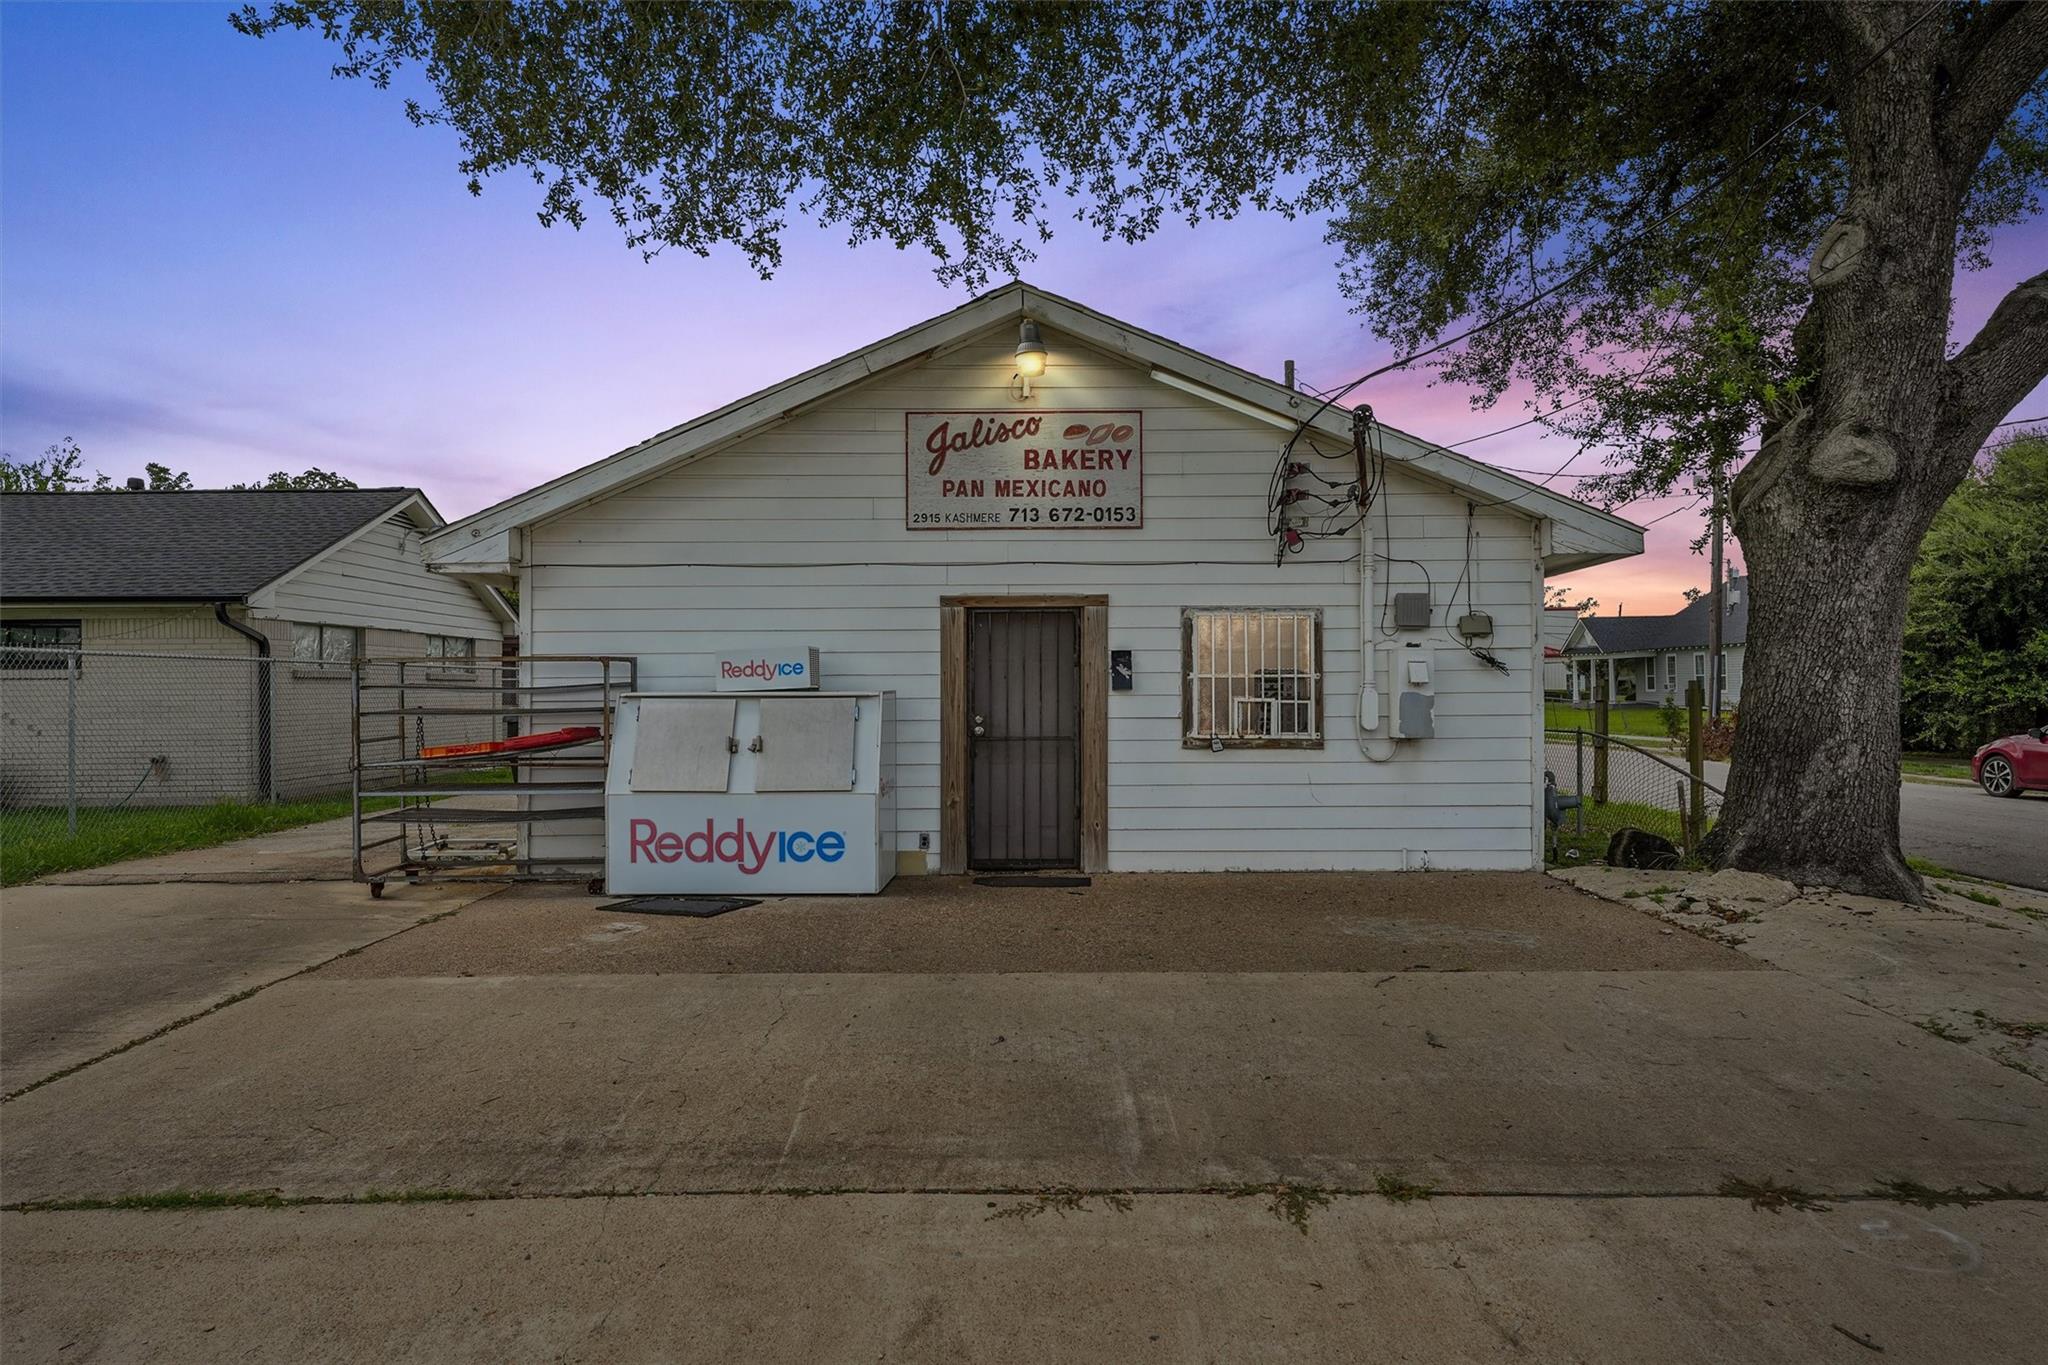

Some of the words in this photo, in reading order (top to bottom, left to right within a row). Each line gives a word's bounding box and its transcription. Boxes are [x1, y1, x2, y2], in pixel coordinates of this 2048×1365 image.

[926, 416, 1042, 476] Jalisco
[1024, 449, 1133, 470] BAKERY
[942, 480, 984, 497] PAN
[995, 480, 1107, 497] MEXICANO
[913, 513, 941, 523] 2915
[945, 513, 1000, 523] KASHMERE
[1009, 508, 1040, 522] 713
[1049, 507, 1136, 522] 672-0153
